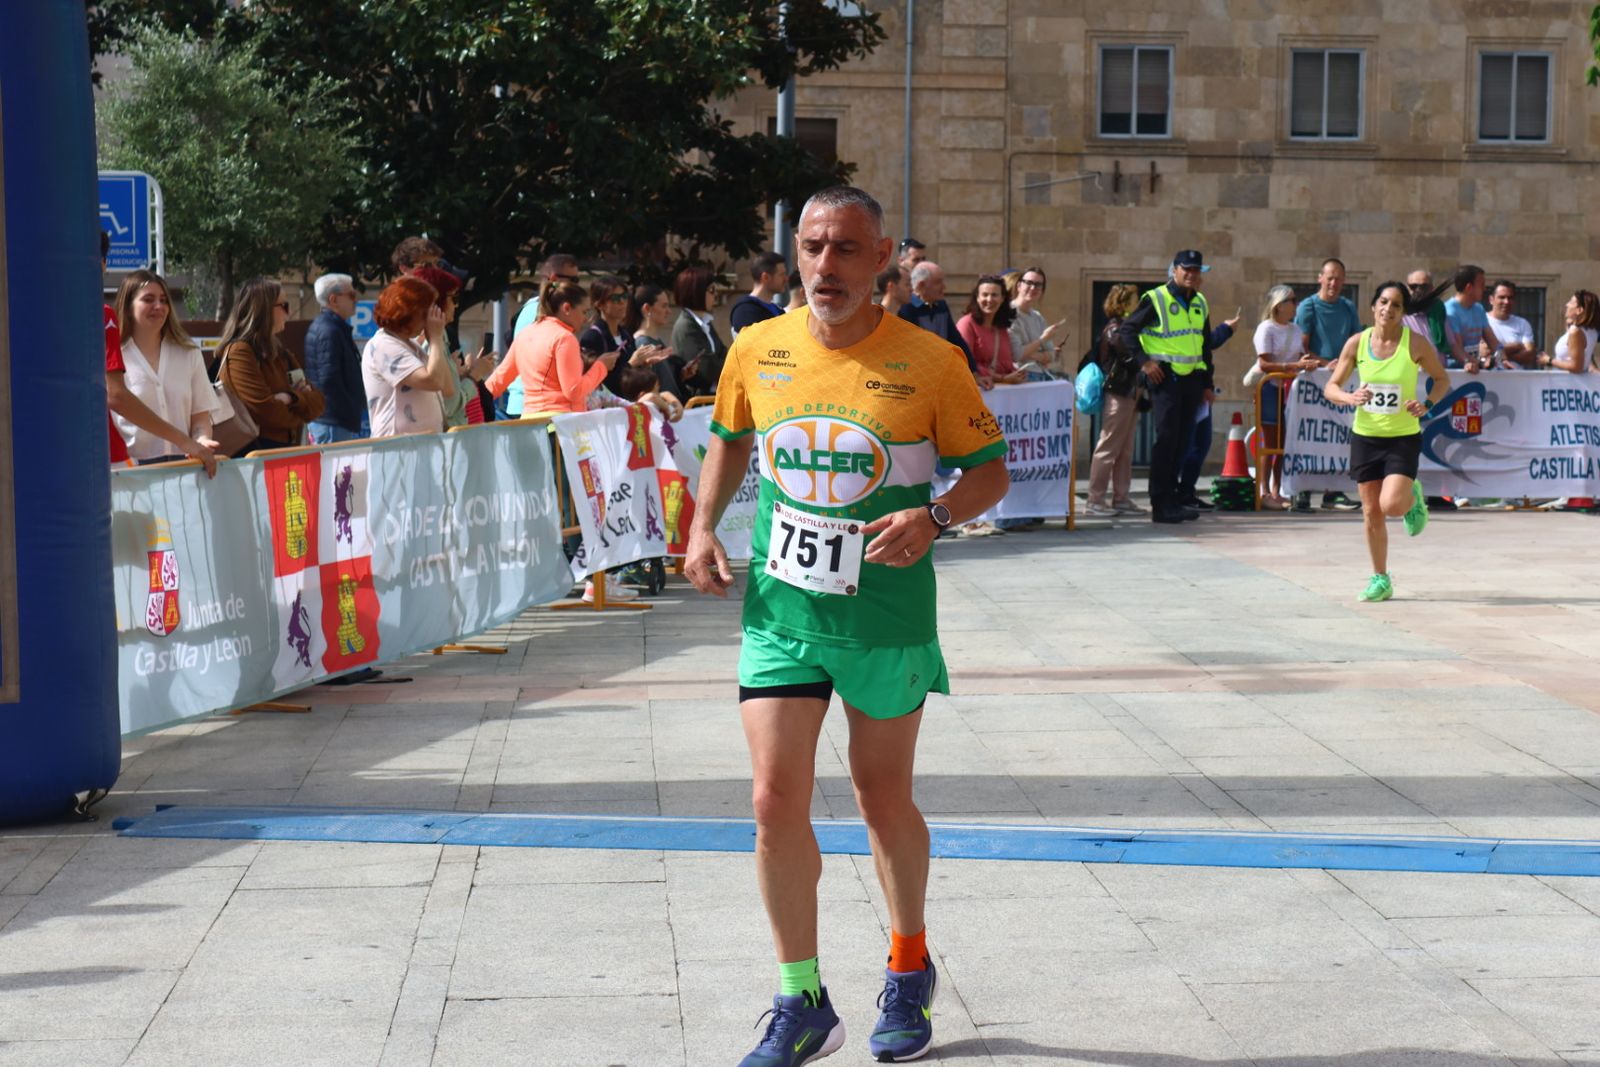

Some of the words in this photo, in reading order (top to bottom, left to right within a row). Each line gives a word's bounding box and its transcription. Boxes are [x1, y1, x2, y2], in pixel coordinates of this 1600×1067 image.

[1542, 389, 1600, 413] FEDERAC
[760, 406, 794, 430] CLUB
[804, 402, 892, 440] DEPORTIVO
[997, 408, 1051, 434] ERACIÓN
[1057, 408, 1072, 429] DE
[1550, 423, 1600, 446] ATLETIS
[774, 447, 875, 478] ALCER
[1283, 453, 1336, 476] CASTILLA
[1529, 457, 1595, 480] CASTILLA
[415, 505, 437, 538] DE
[793, 515, 829, 529] CASTILLA
[837, 523, 848, 531] LE
[780, 520, 843, 573] 751
[185, 600, 223, 629] Junta
[225, 594, 246, 620] de
[134, 641, 198, 677] Castilla
[199, 641, 213, 675] y
[214, 633, 253, 662] León
